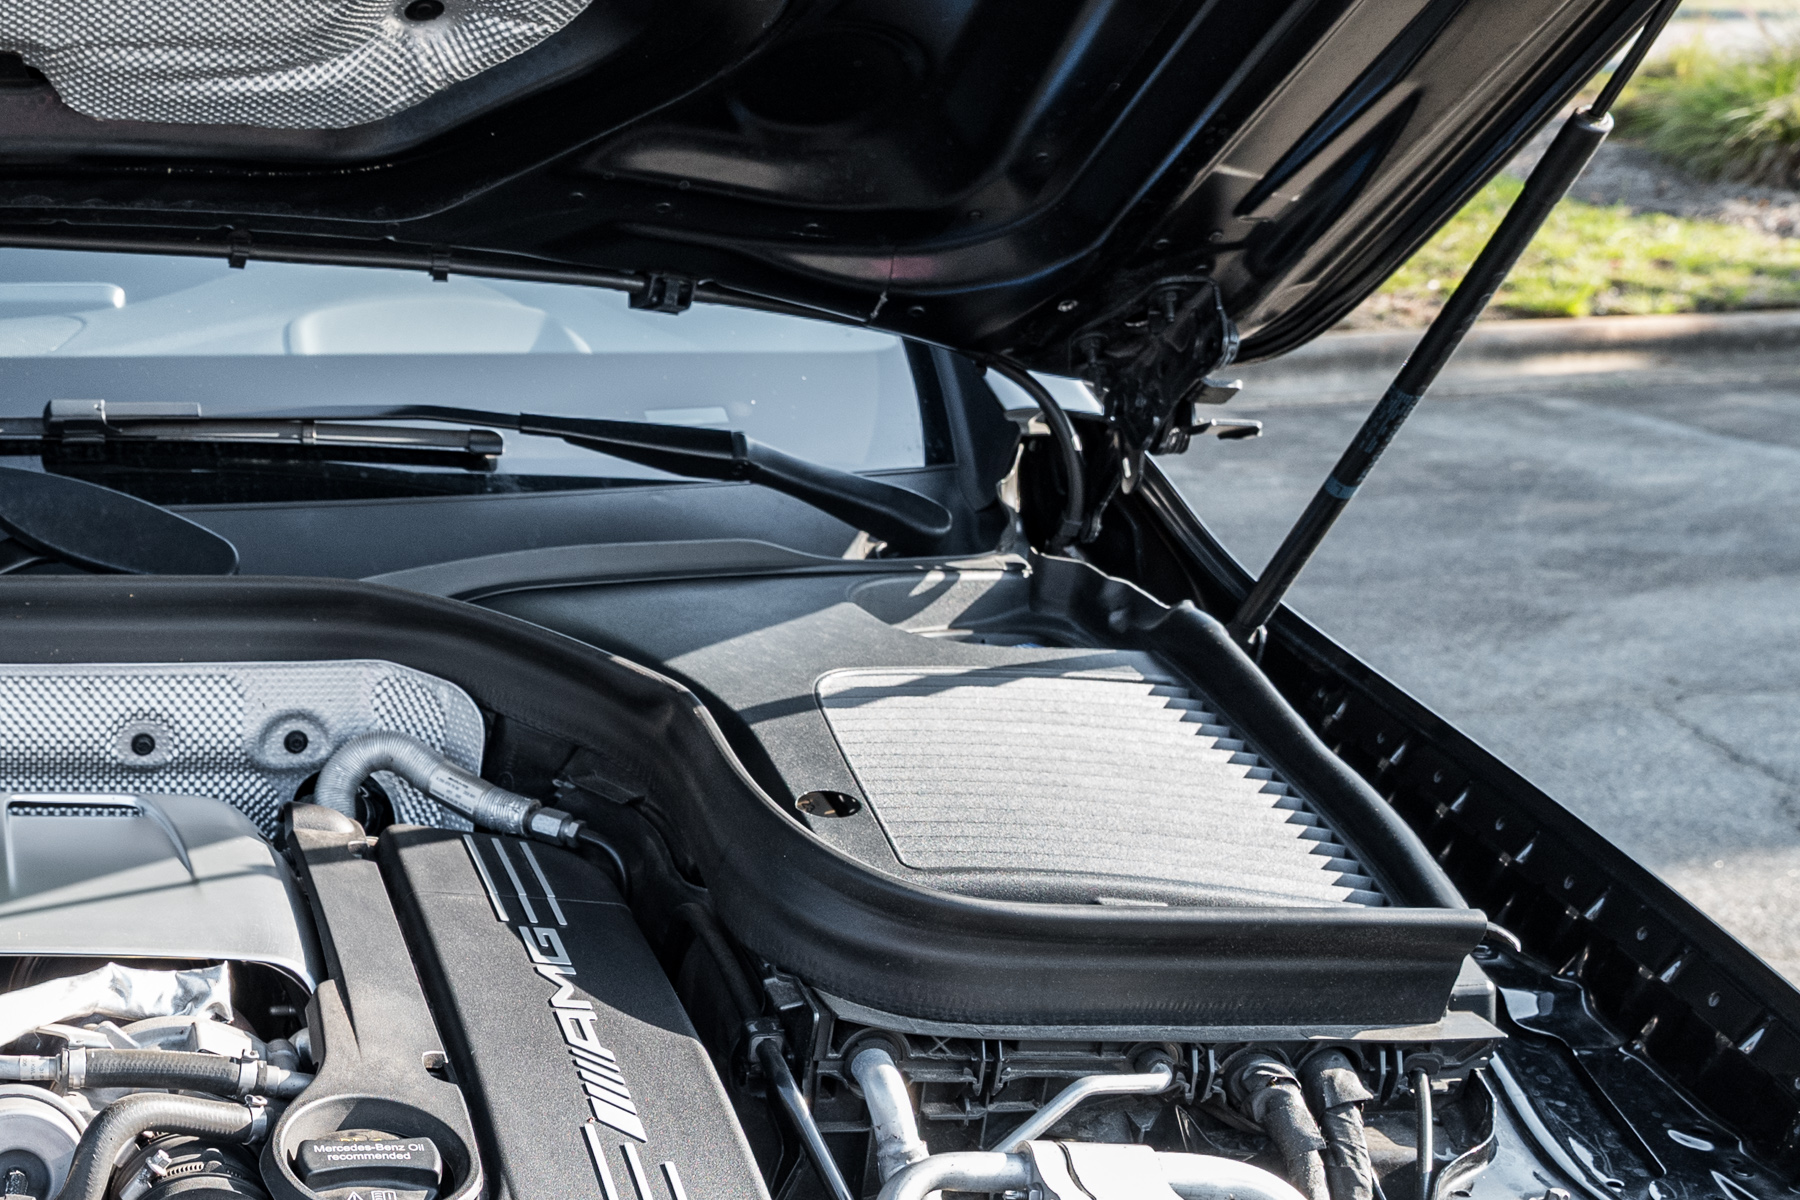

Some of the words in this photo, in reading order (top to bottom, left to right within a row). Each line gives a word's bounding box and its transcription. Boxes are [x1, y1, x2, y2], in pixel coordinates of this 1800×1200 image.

[313, 1143, 406, 1153] Mercedes-Benz
[408, 1143, 425, 1152] Oil
[327, 1152, 411, 1161] recommended
